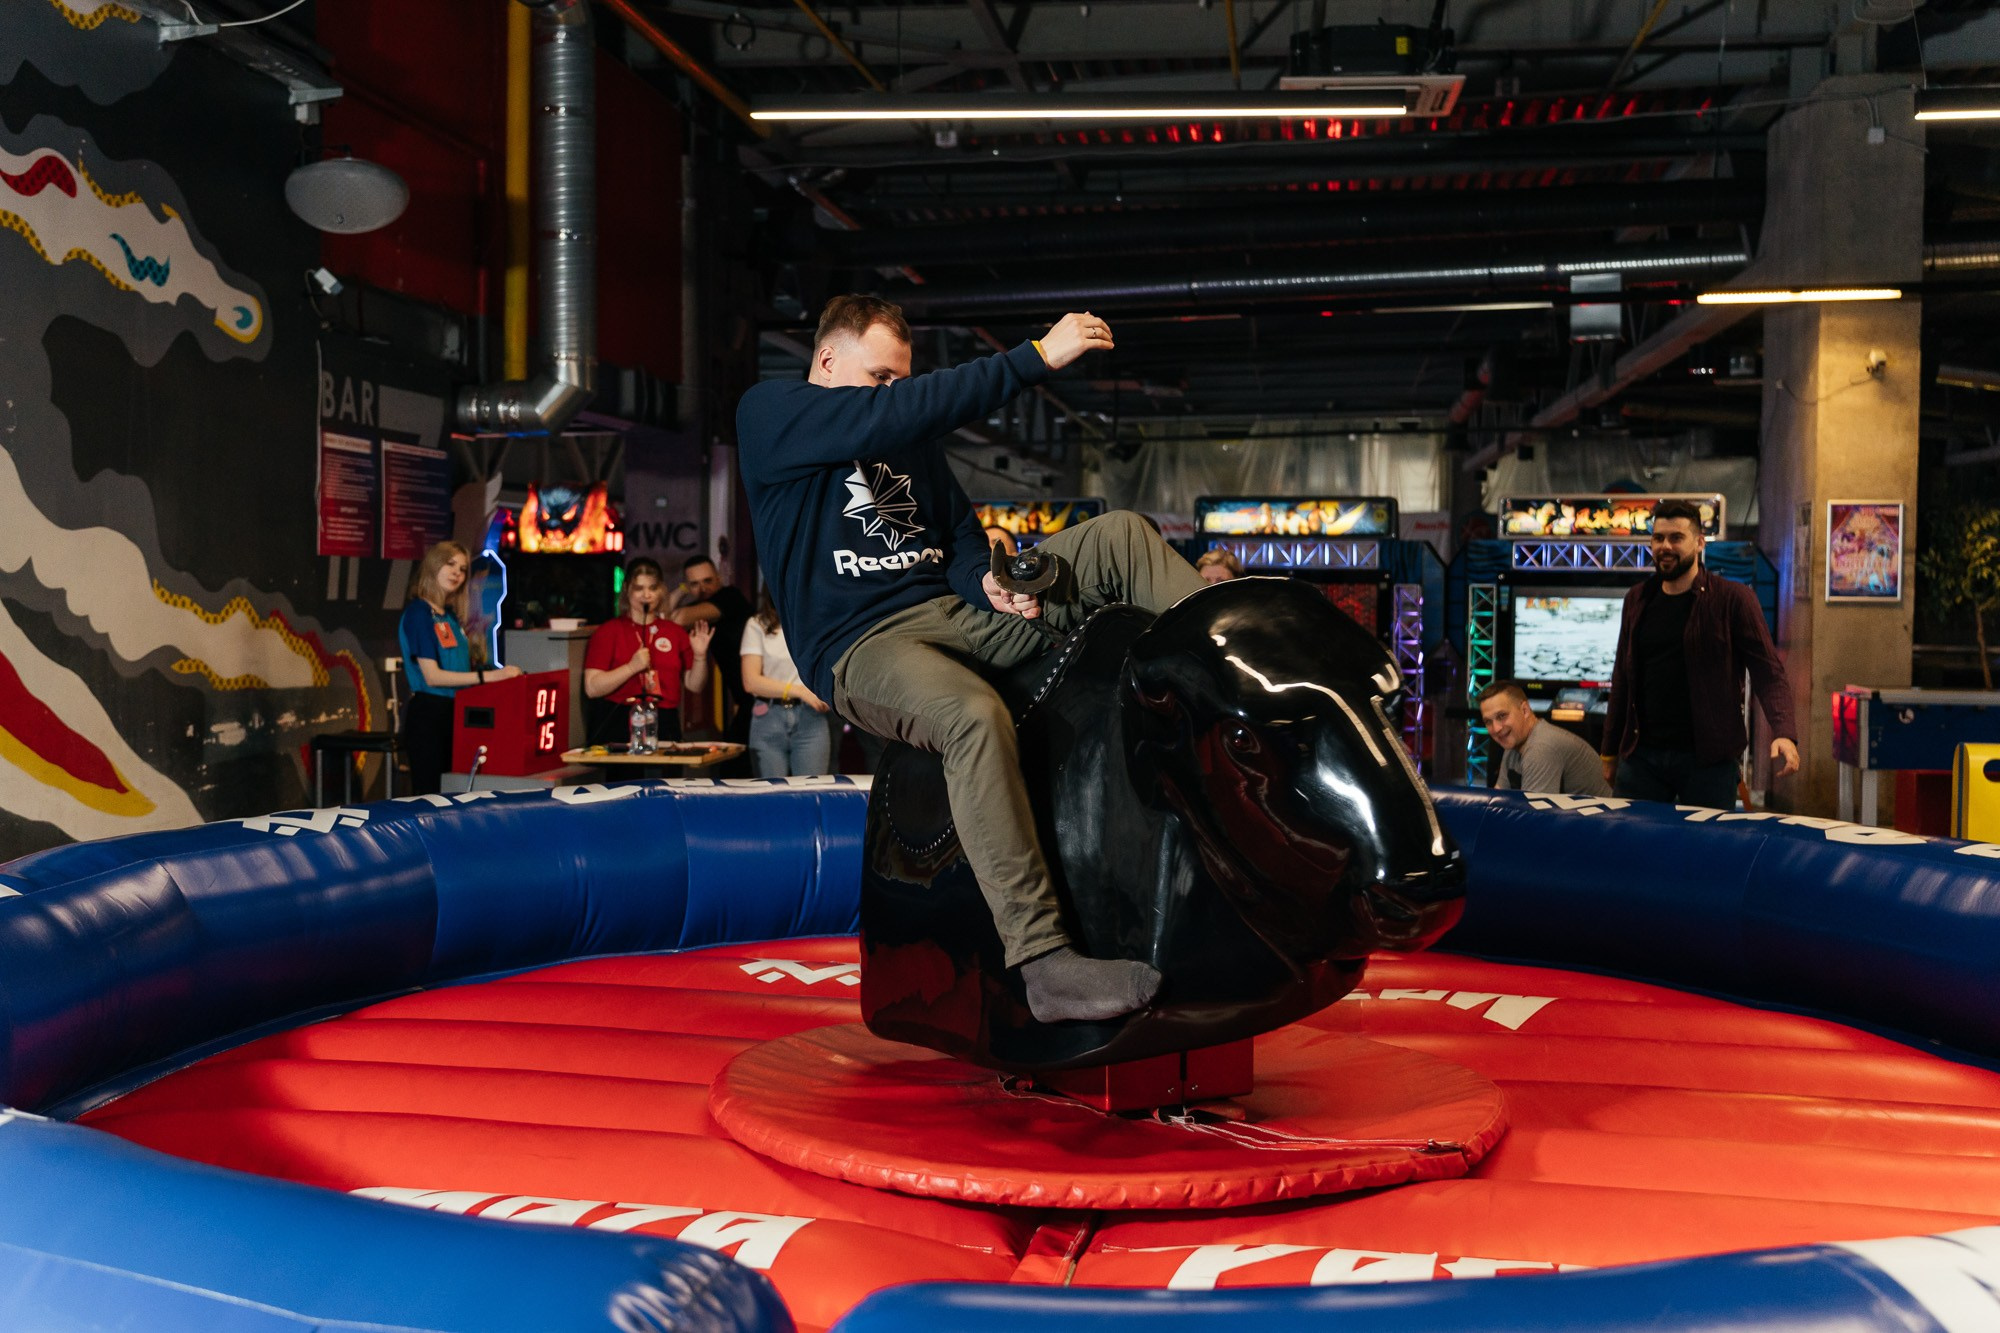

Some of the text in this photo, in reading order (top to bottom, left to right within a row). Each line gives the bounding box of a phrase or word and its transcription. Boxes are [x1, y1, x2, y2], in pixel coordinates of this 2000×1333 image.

[322, 370, 375, 427] BAR
[643, 521, 699, 551] WC
[535, 688, 558, 718] 01
[538, 721, 556, 750] 15
